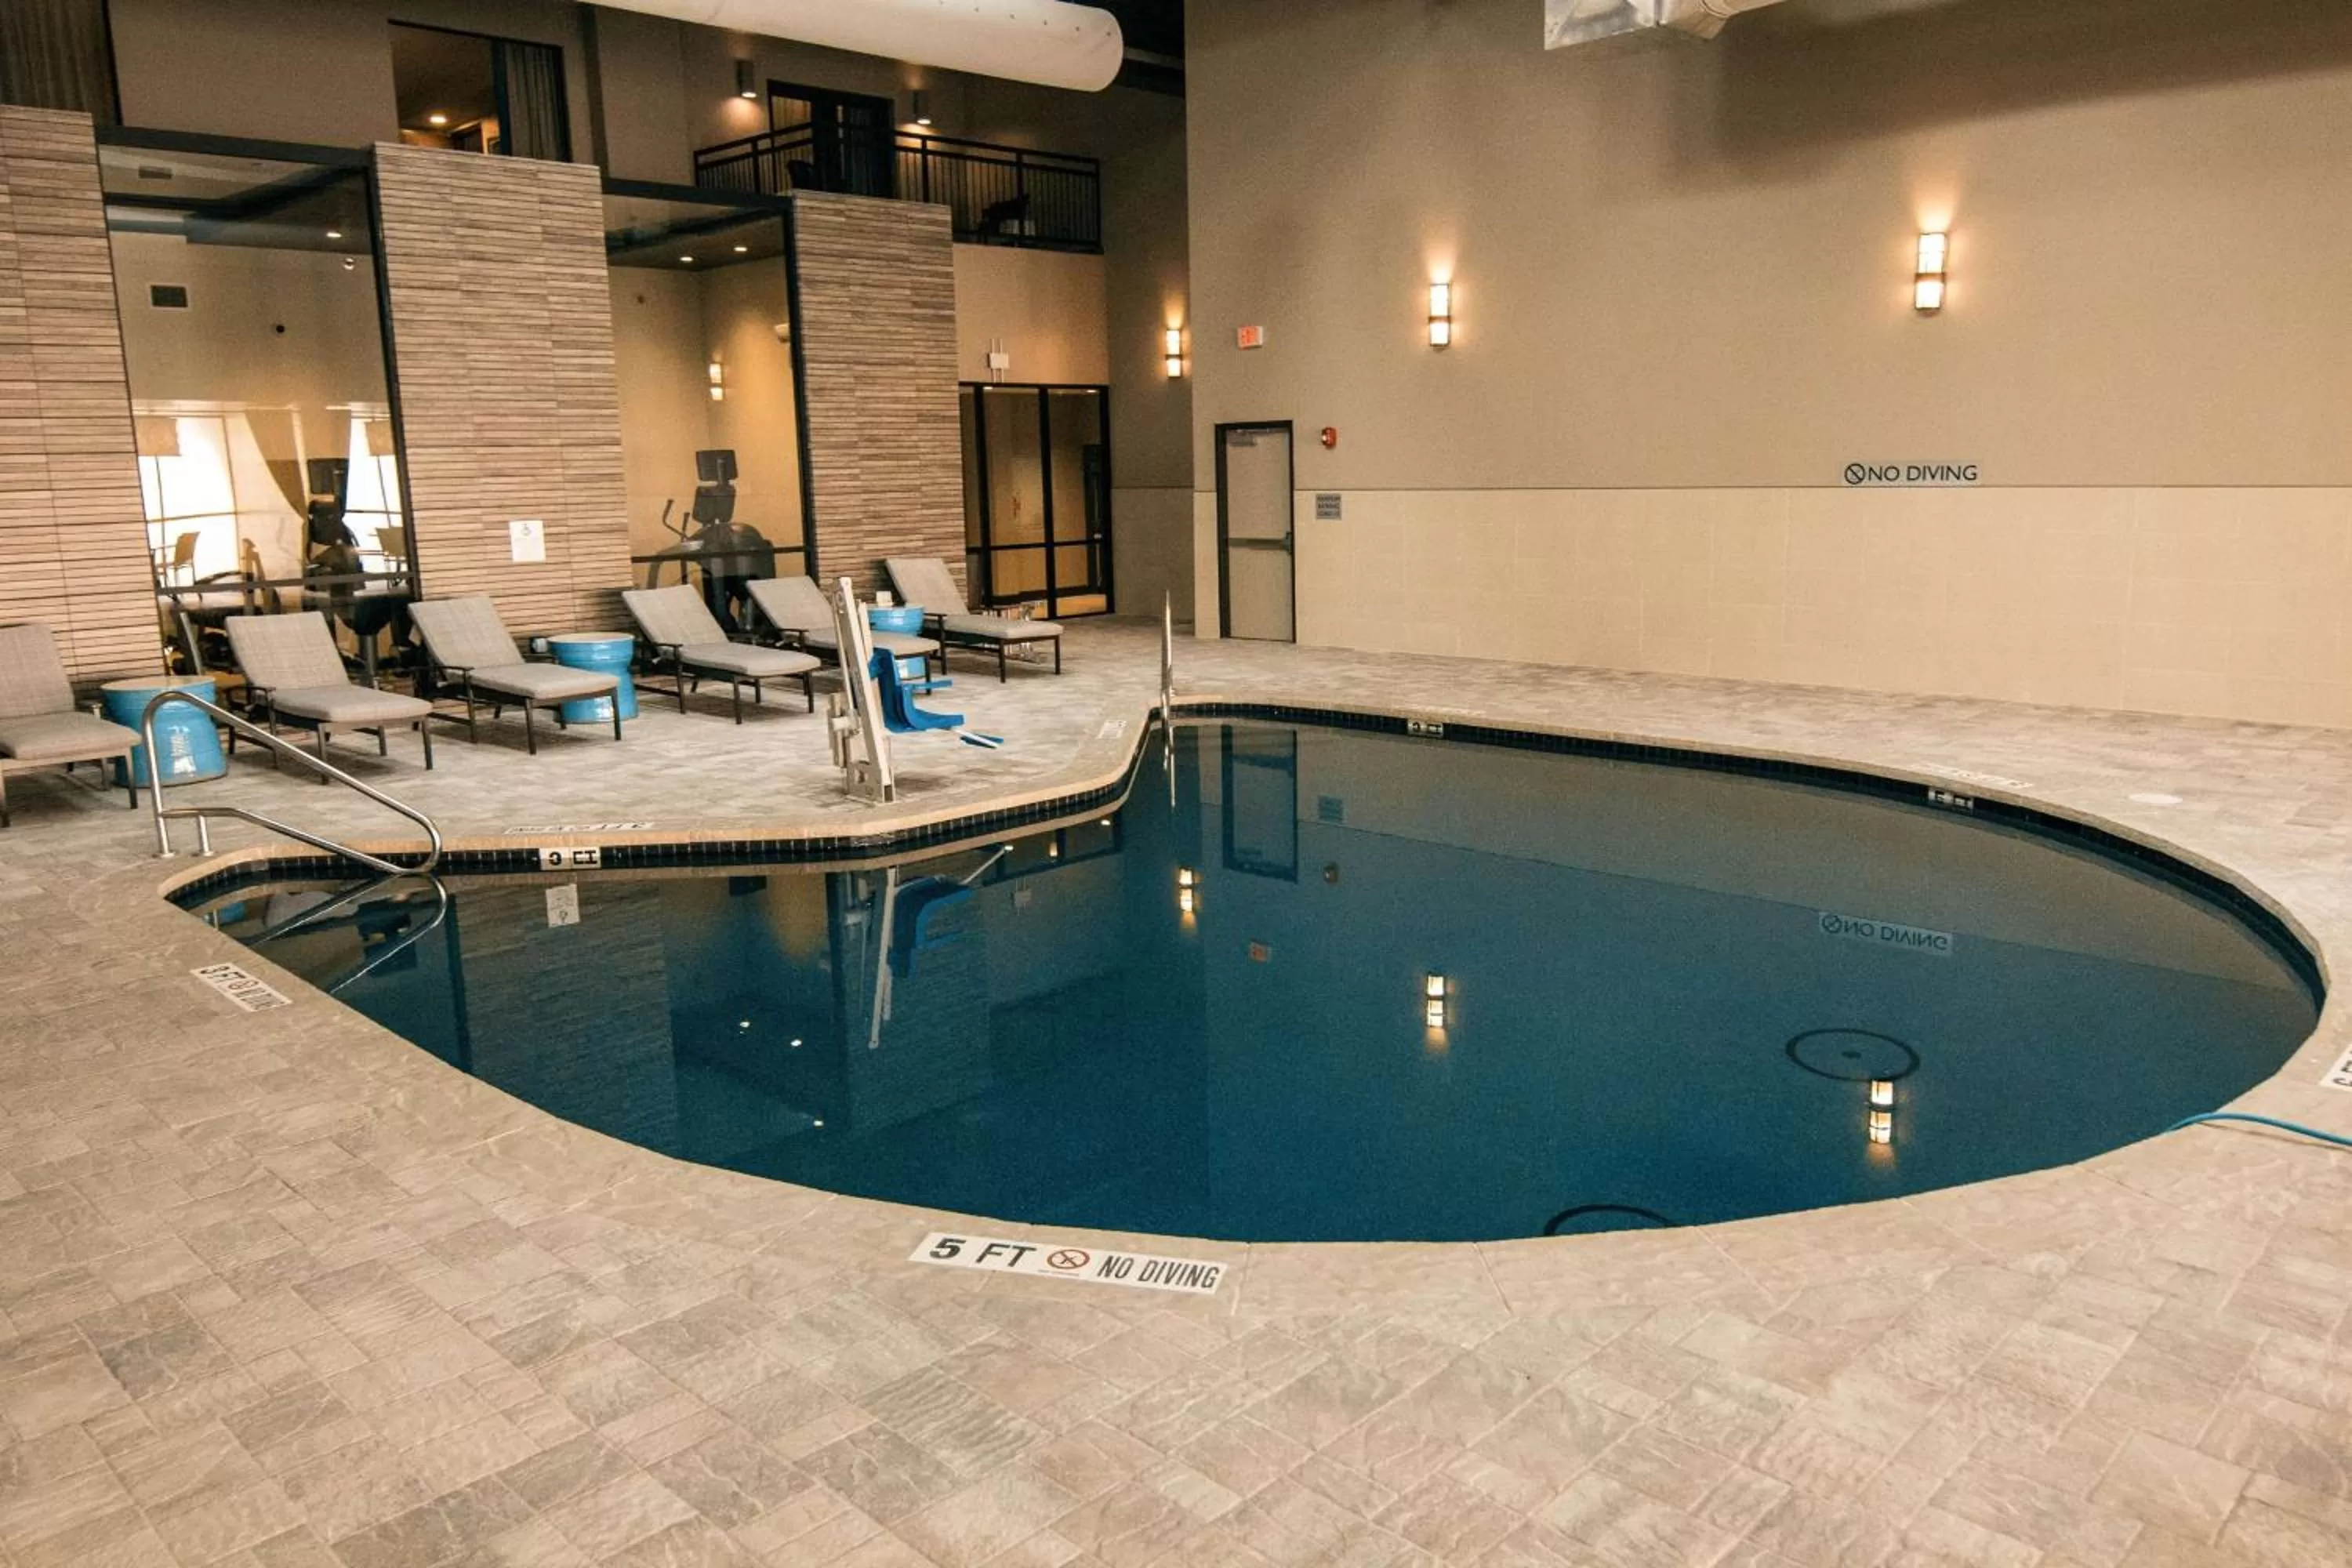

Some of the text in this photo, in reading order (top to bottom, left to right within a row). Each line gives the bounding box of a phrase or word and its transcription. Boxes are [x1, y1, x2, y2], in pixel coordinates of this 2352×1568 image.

[1868, 464, 1977, 481] NO DIVING
[929, 1237, 1221, 1290] 5 FT NO DIVING
